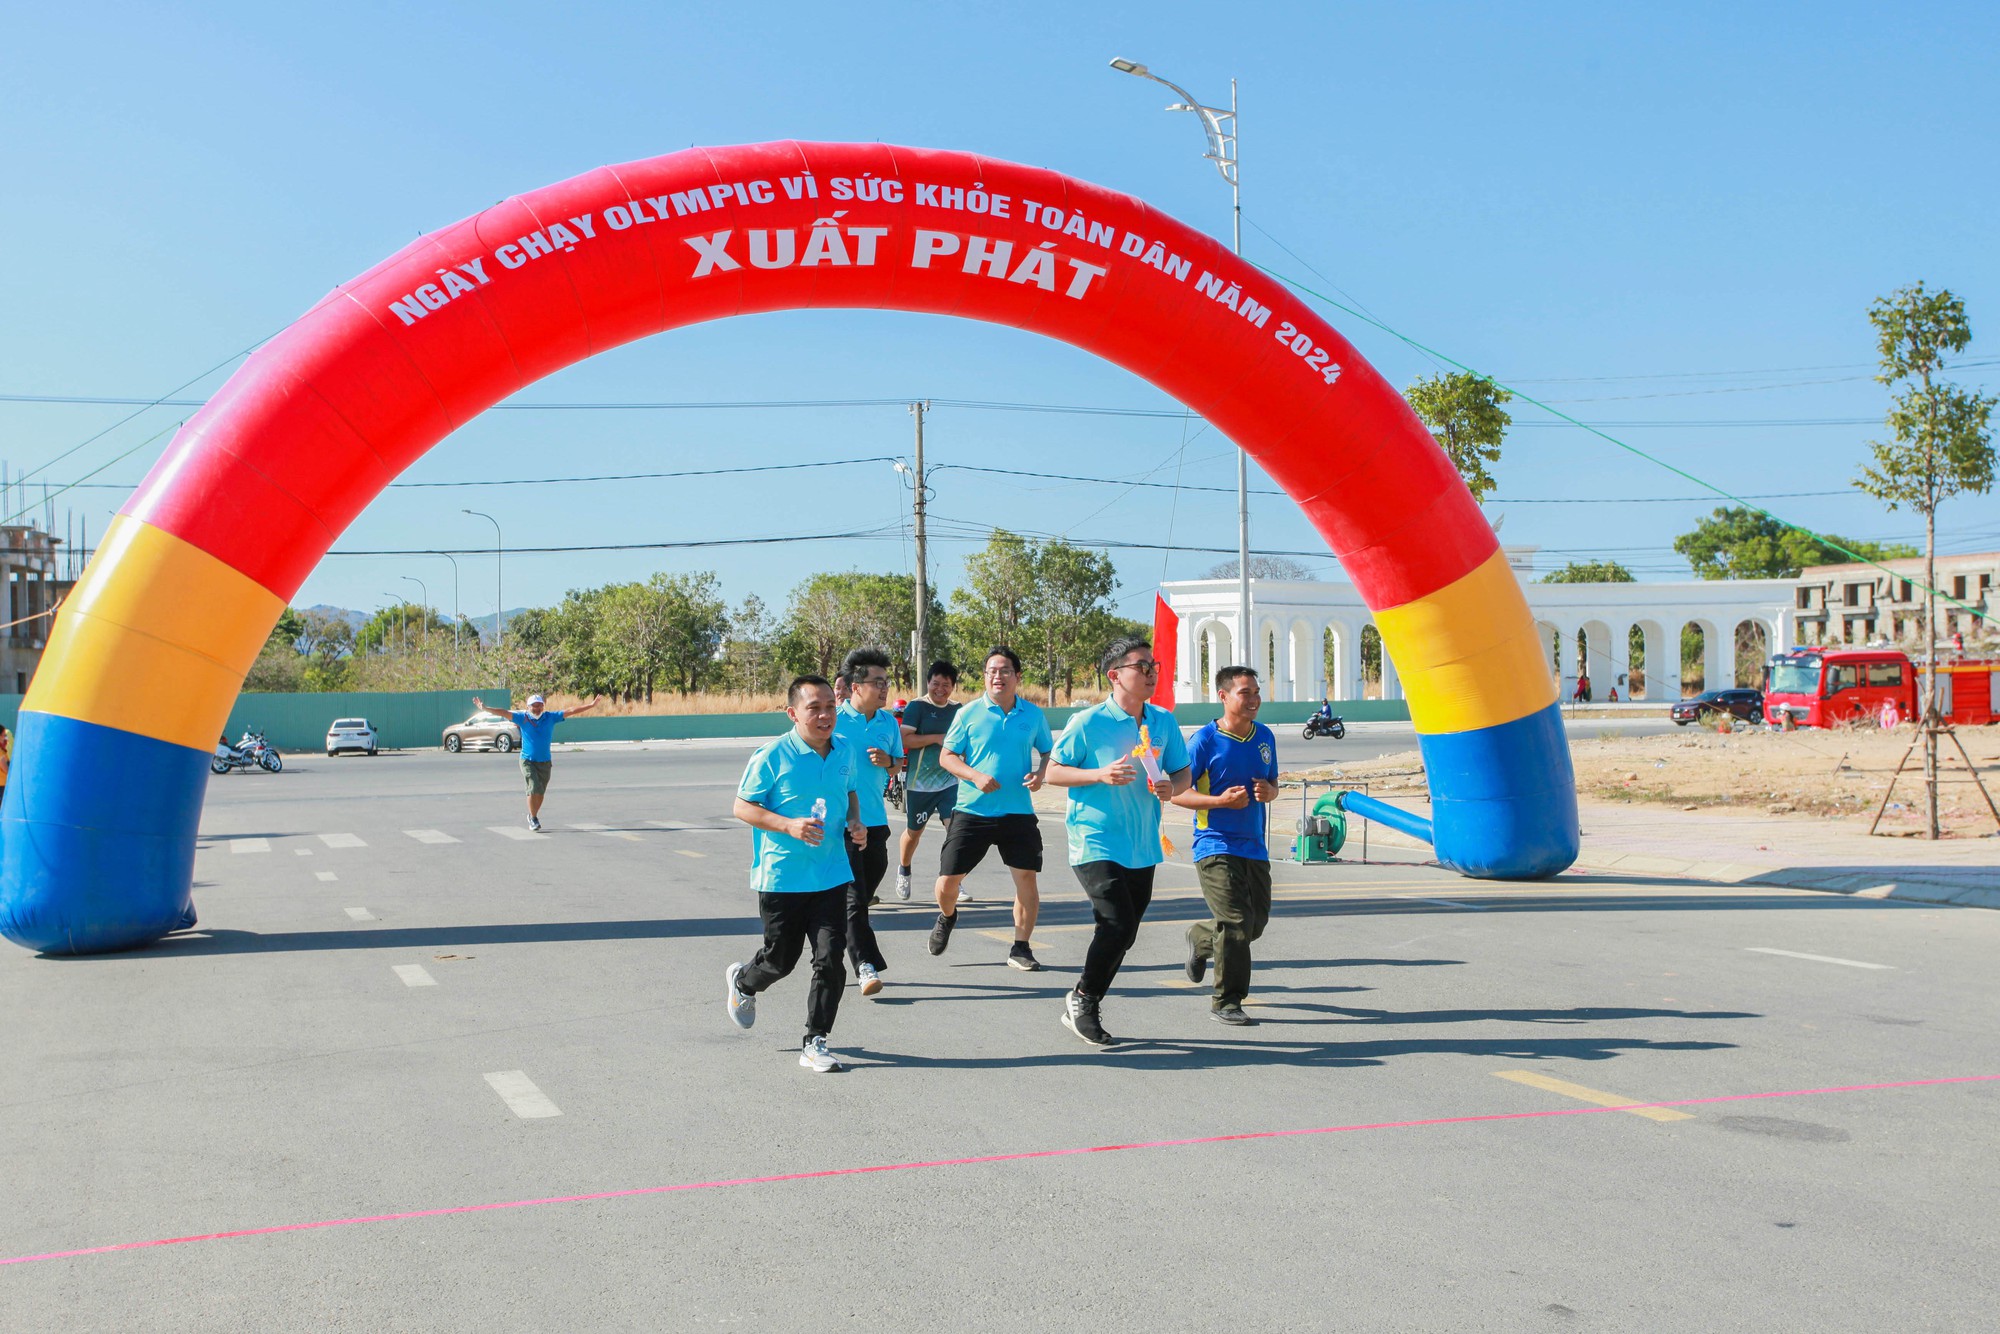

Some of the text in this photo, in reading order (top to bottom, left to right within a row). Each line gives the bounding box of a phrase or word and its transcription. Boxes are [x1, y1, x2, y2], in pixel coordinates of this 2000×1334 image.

[388, 171, 1343, 385] NGÀY CHẠY OLYMPIC VÌ SỨC KHỎE TOÀN DÂN NĂM 2024
[684, 210, 1107, 301] XUẤT PHÁT
[917, 812, 928, 824] 20
